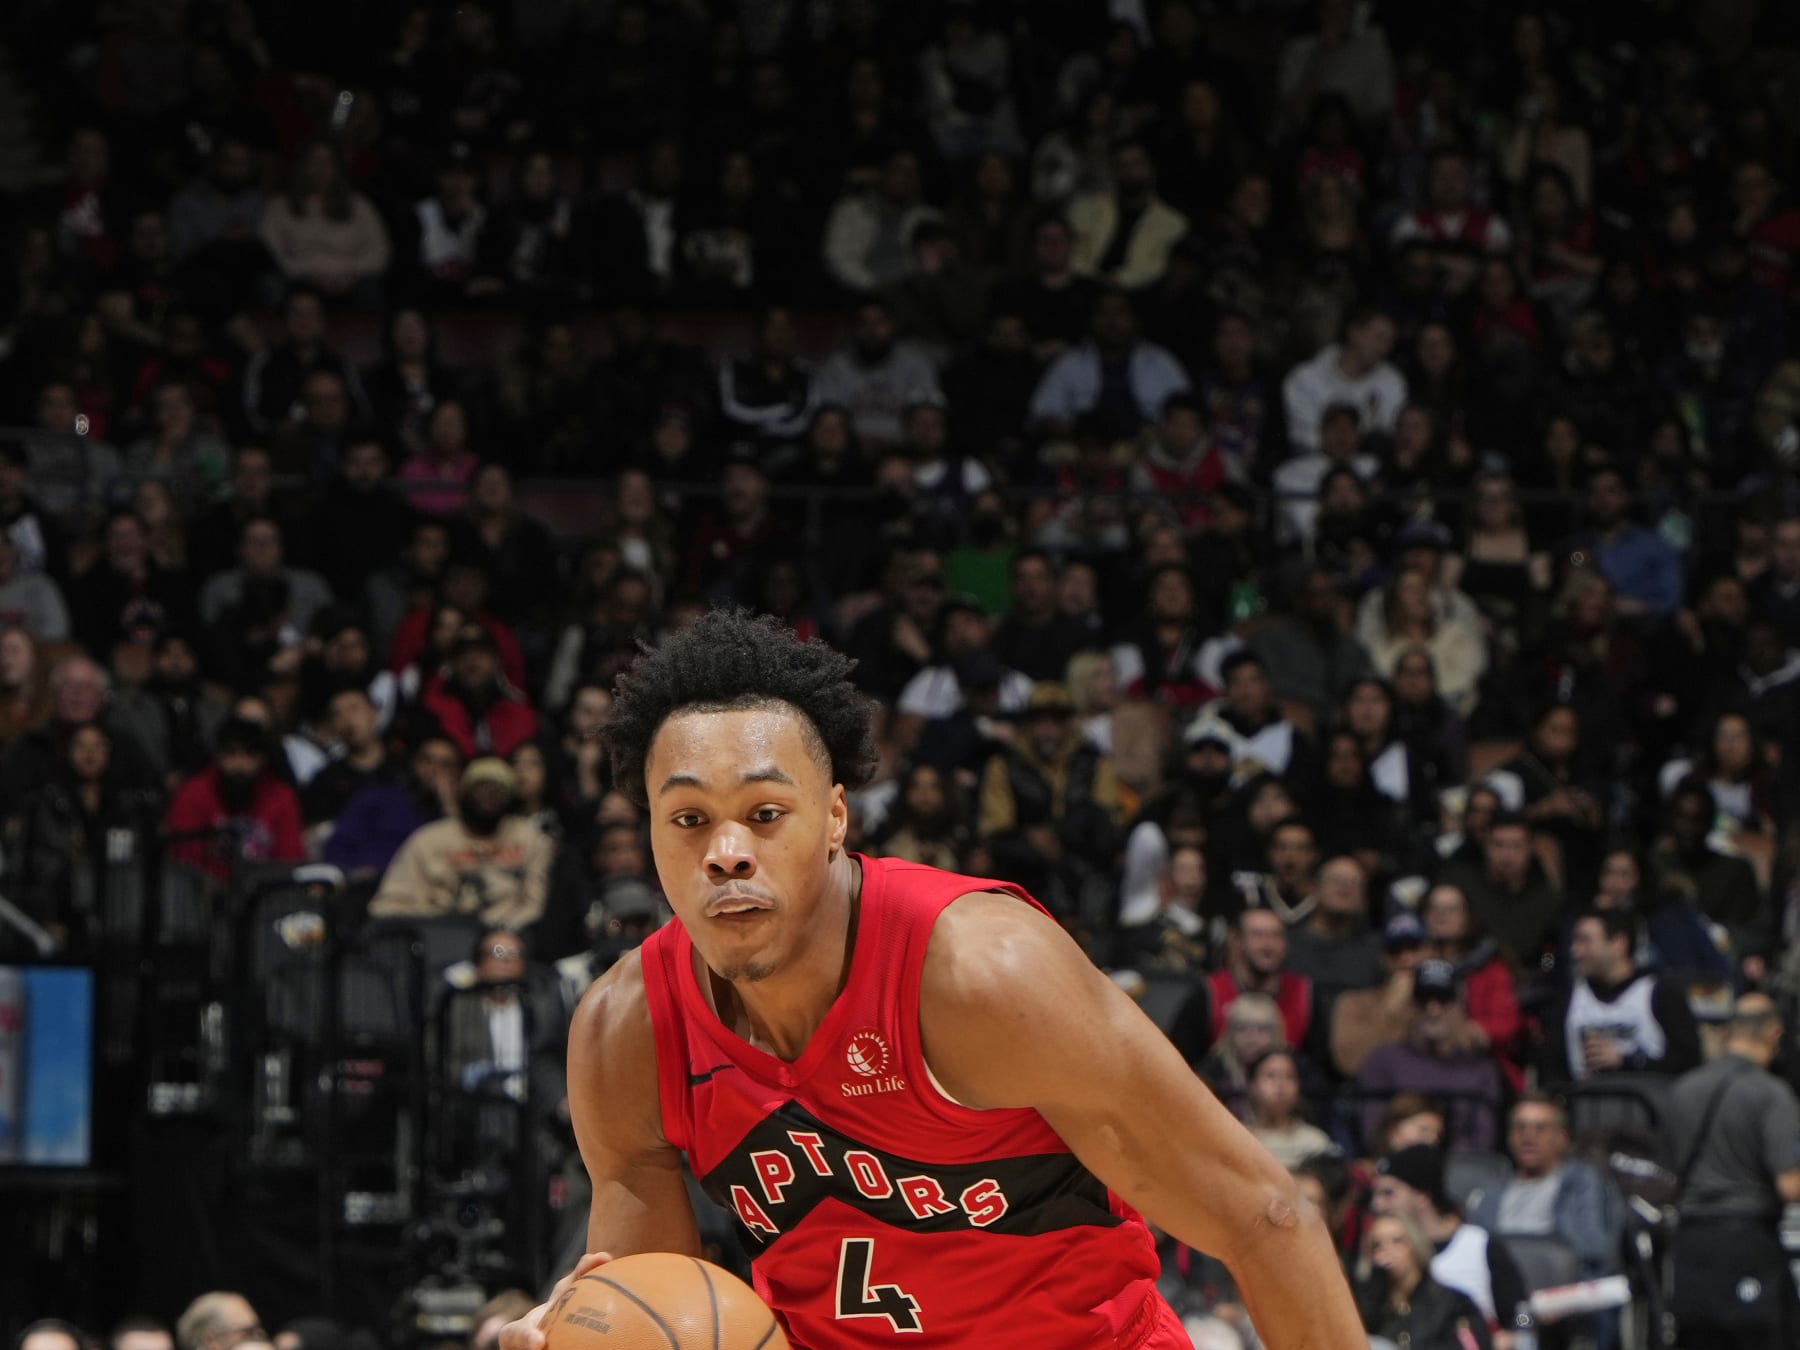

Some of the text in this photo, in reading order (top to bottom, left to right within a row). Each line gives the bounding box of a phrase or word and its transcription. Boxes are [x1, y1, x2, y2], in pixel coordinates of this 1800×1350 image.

[841, 1075, 905, 1097] Sun Life
[730, 1130, 1008, 1239] APTORS
[835, 1237, 923, 1333] 4
